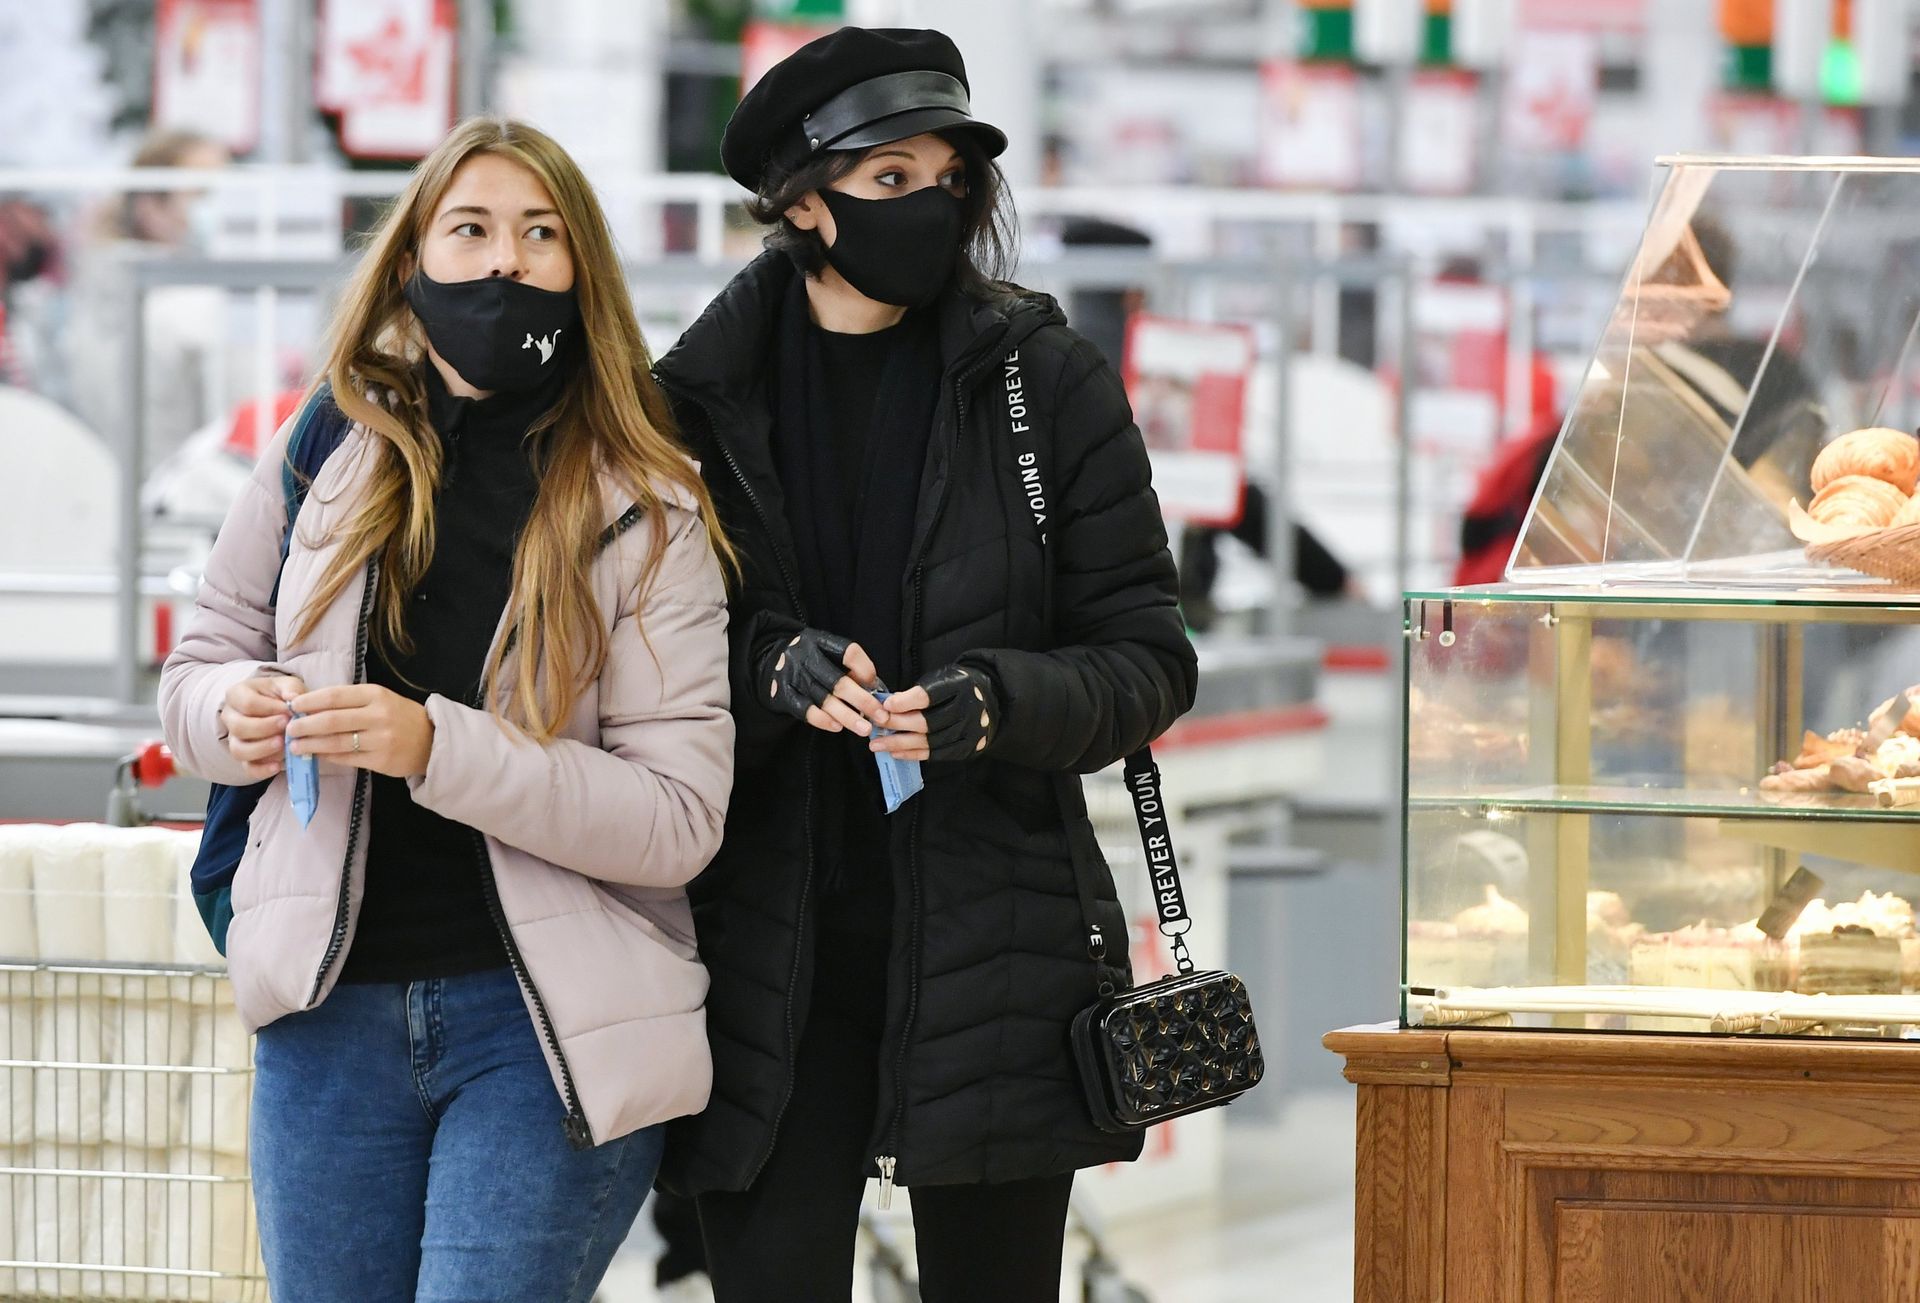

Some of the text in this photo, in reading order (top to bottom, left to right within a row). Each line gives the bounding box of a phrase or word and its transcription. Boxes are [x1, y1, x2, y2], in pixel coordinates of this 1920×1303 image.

[1004, 349, 1047, 525] YOUNG FOREVE
[1134, 770, 1182, 920] OREVER YOUN
